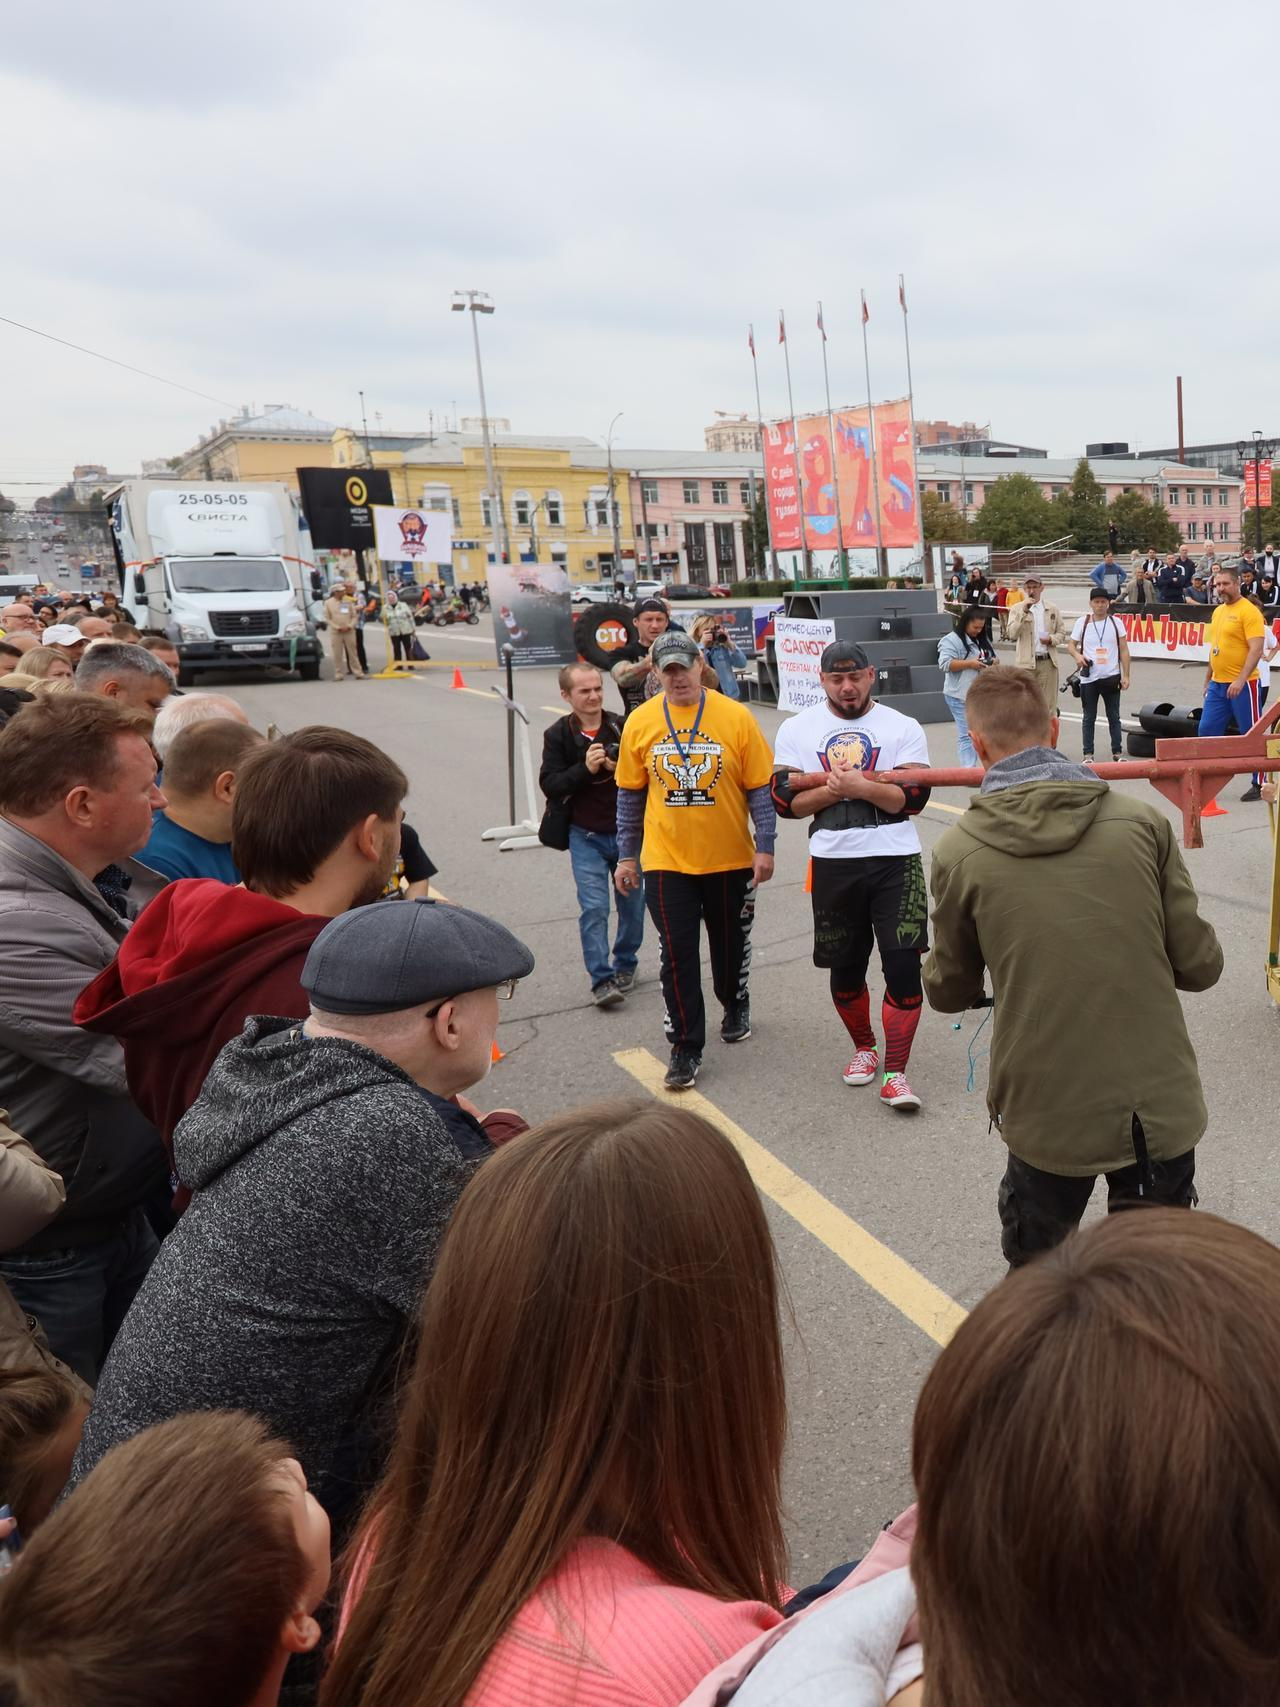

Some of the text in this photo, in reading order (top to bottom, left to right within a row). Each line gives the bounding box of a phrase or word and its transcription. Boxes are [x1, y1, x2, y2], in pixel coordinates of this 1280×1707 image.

[178, 494, 248, 505] 25-05-05
[880, 622, 891, 631] 200
[1113, 613, 1155, 643] ИЛА
